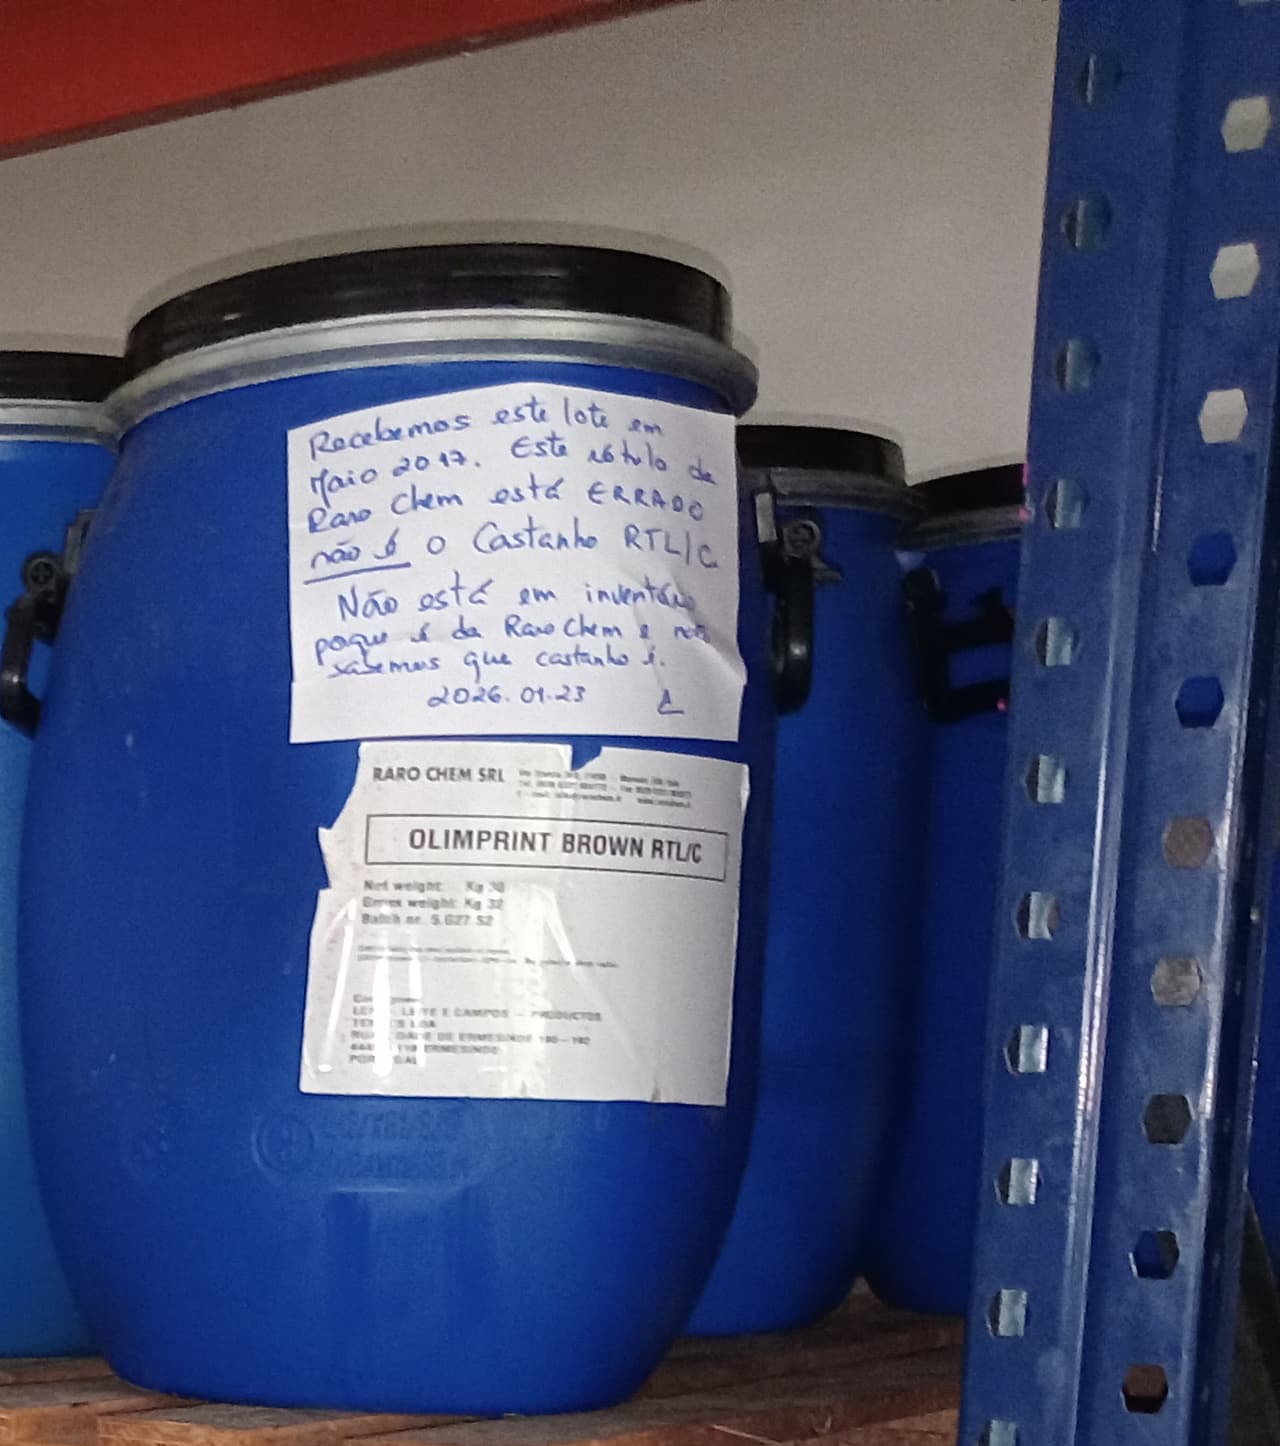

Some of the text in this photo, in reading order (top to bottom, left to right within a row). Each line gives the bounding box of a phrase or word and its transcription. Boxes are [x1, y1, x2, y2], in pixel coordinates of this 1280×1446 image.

[309, 396, 664, 461] Recebemos este lote em
[310, 468, 378, 509] Maio
[511, 430, 568, 459] Este
[390, 484, 464, 515] Chem
[489, 472, 564, 505] está
[587, 481, 705, 522] ERRADO
[310, 540, 361, 569] não
[473, 514, 599, 554] Castanho
[338, 584, 398, 622] Não
[417, 569, 495, 612] está
[519, 587, 557, 606] em
[563, 613, 623, 638] Chem
[463, 651, 512, 684] que
[536, 643, 629, 667] castanho
[372, 765, 506, 784] RARO CHEM SRL
[409, 827, 551, 853] OLIMPRINT
[561, 833, 643, 858] BROWN
